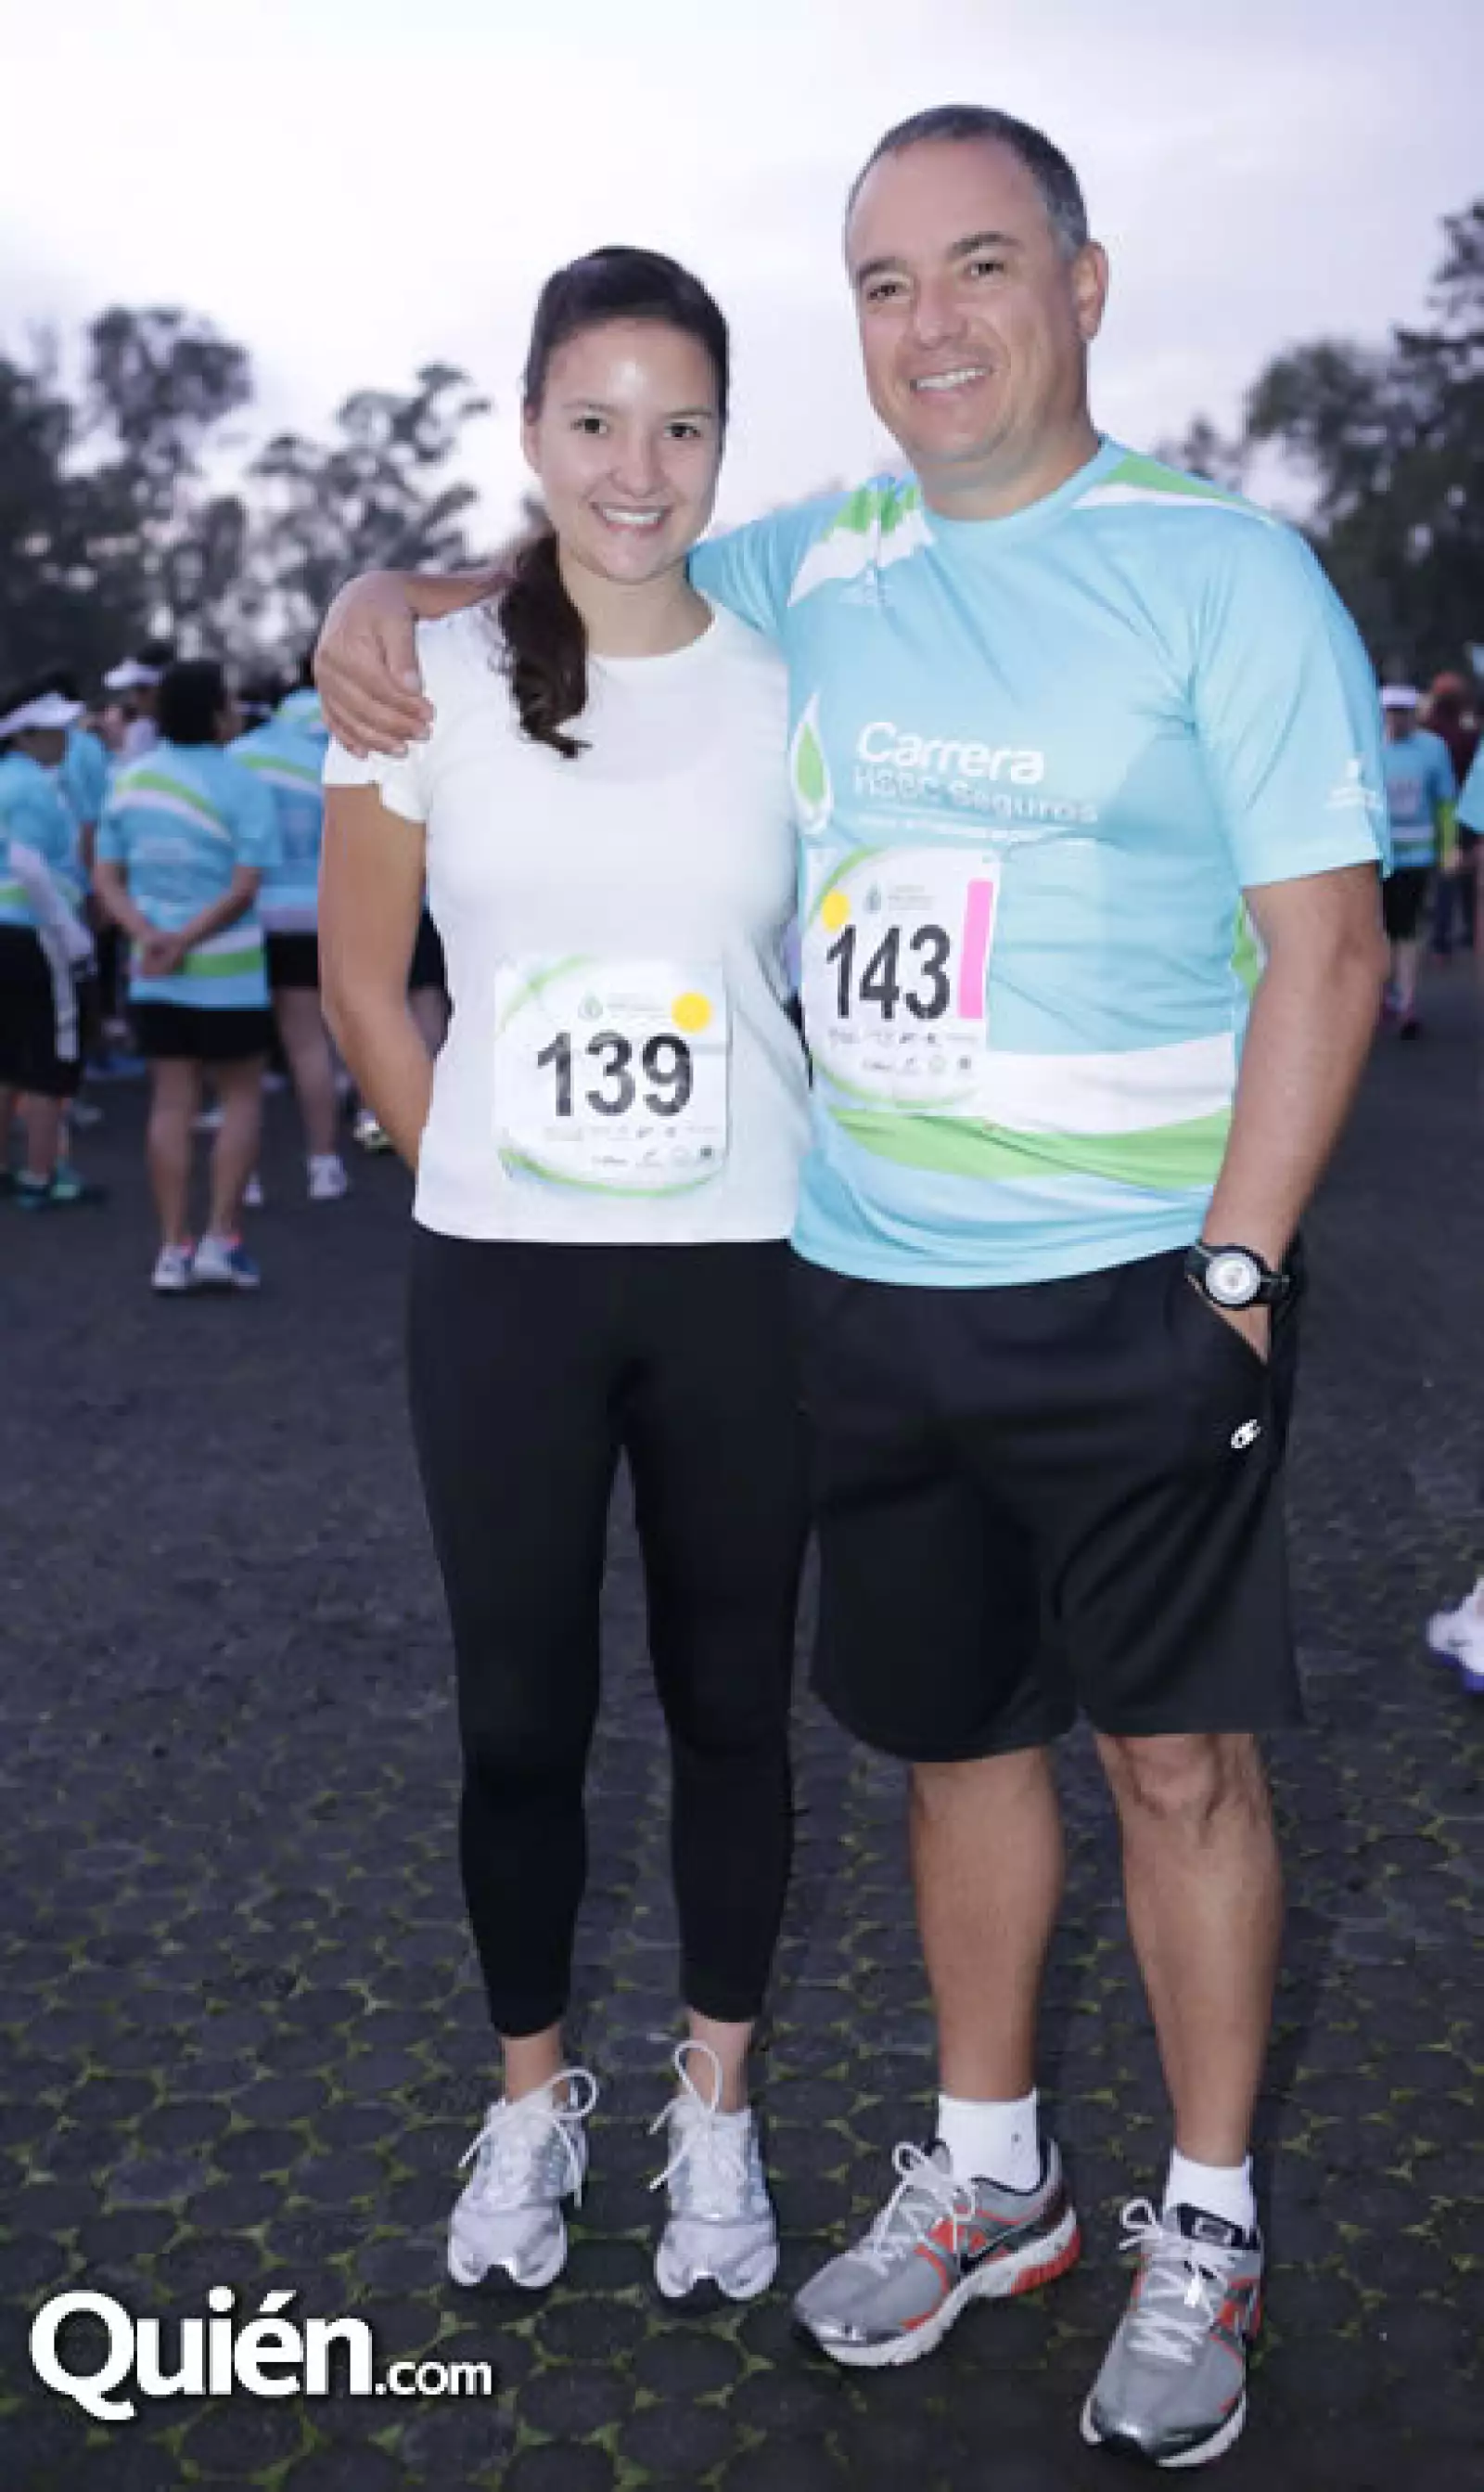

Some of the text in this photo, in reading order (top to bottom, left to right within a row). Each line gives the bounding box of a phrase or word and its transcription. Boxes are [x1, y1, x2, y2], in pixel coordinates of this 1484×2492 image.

[857, 721, 1044, 785] Carrera
[826, 924, 951, 1020] 143
[537, 1032, 694, 1116] 139
